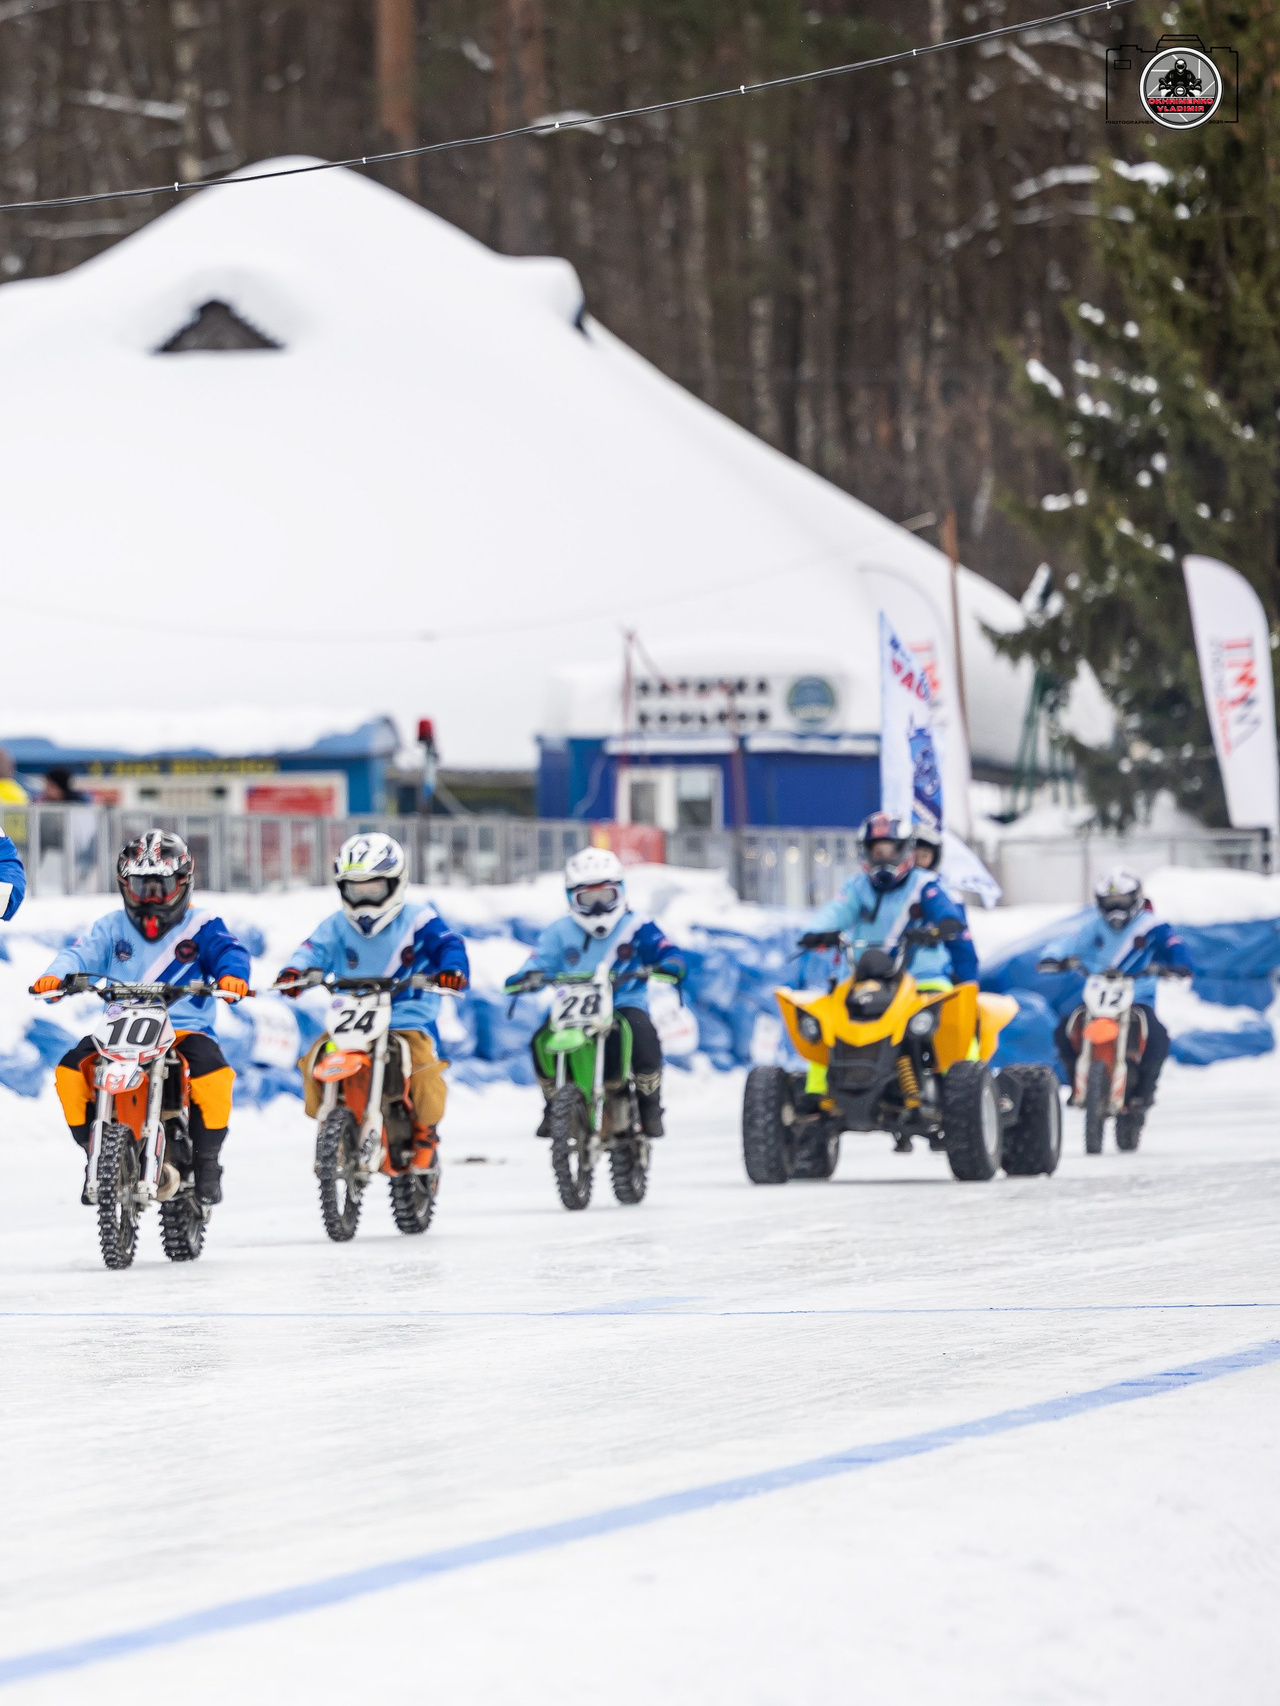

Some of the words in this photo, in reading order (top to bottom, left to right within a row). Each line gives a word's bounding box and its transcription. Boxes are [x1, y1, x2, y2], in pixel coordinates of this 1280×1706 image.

[558, 993, 601, 1021] 28
[1099, 990, 1124, 1007] 12
[106, 1017, 162, 1046] 10
[334, 1009, 377, 1035] 24
